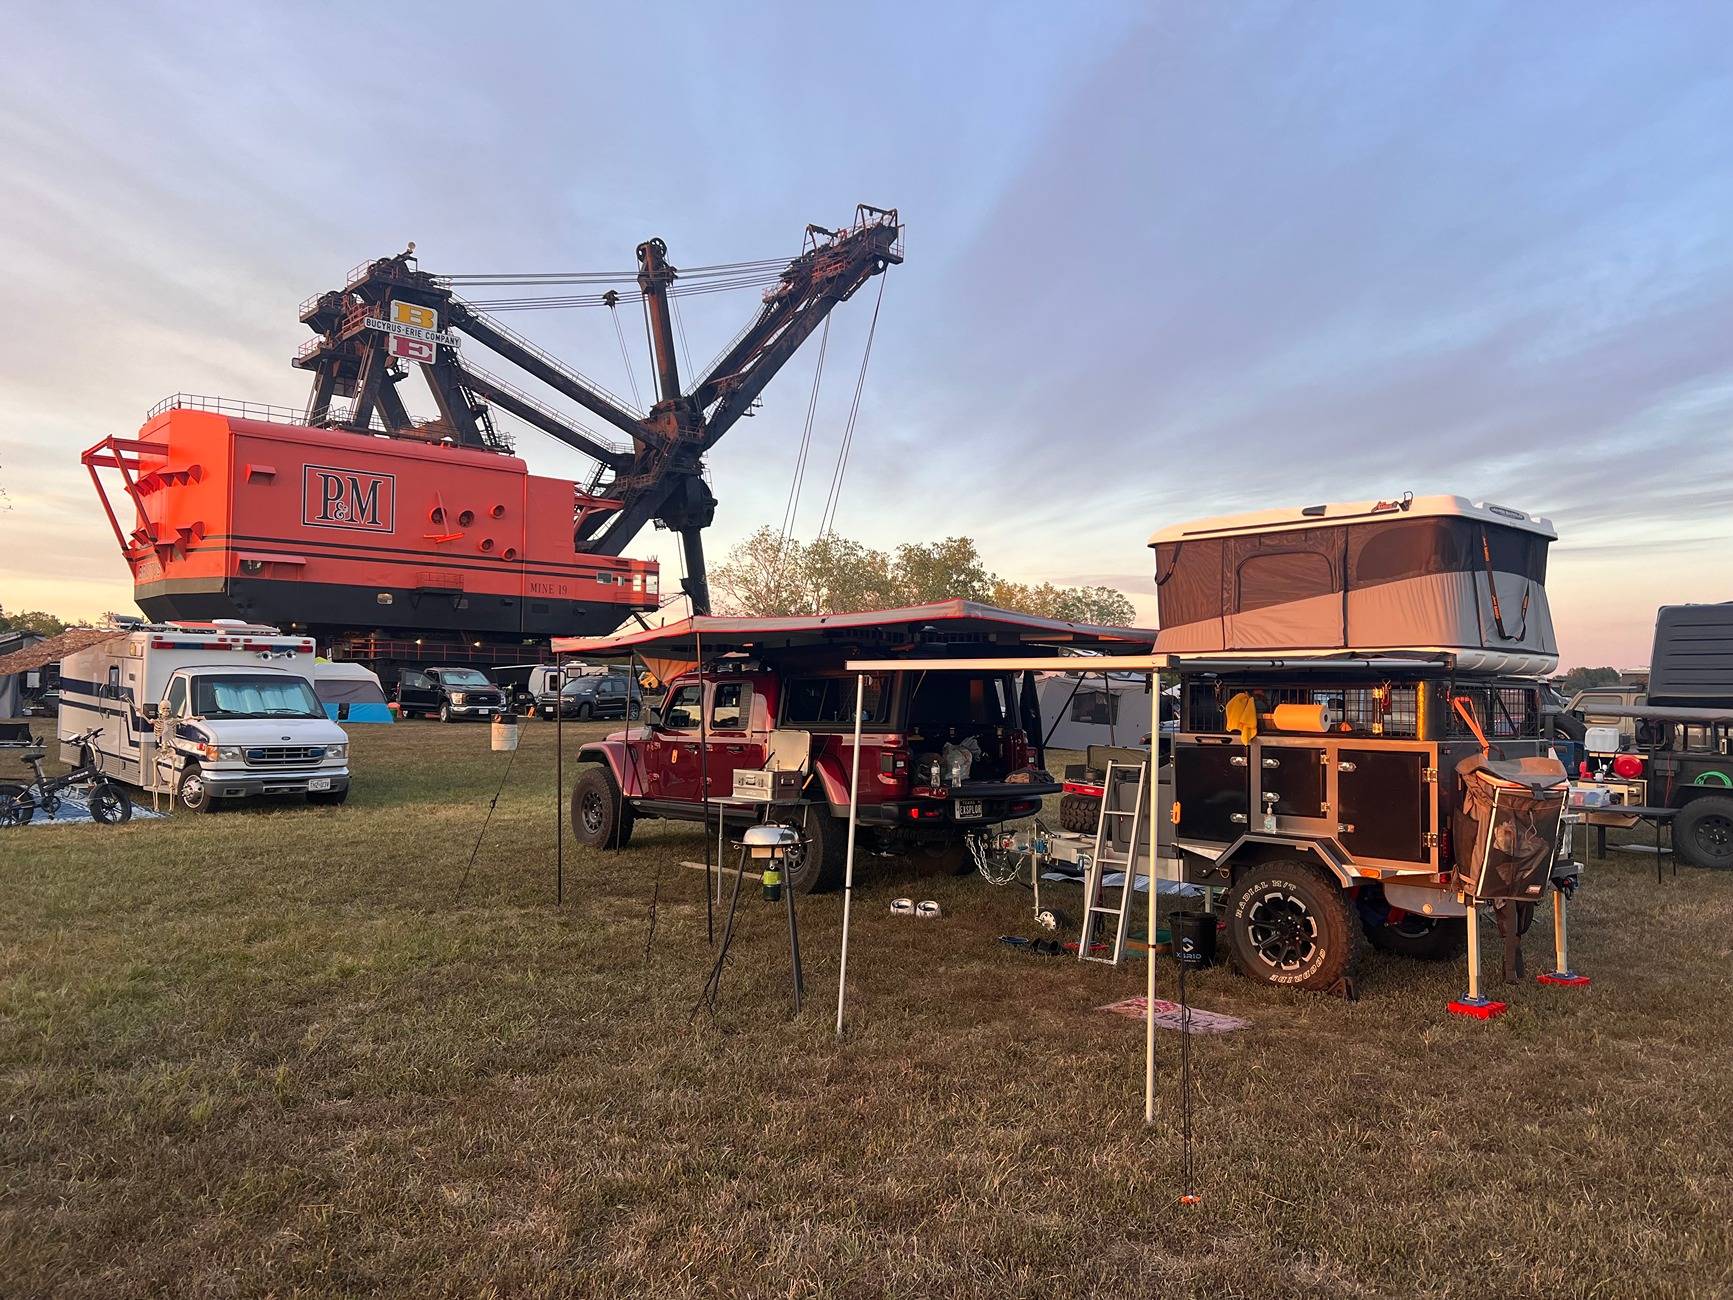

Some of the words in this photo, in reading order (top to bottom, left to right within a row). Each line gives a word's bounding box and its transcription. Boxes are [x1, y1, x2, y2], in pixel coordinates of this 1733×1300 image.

[394, 302, 435, 329] B
[366, 319, 422, 338] BUCYRUS-ERIE
[425, 332, 460, 346] COMPANY
[393, 335, 433, 363] E
[315, 472, 383, 526] P&M
[530, 583, 555, 595] MINE
[558, 584, 568, 595] 19
[1235, 881, 1269, 919] RADIAL
[1271, 879, 1297, 892] M/T
